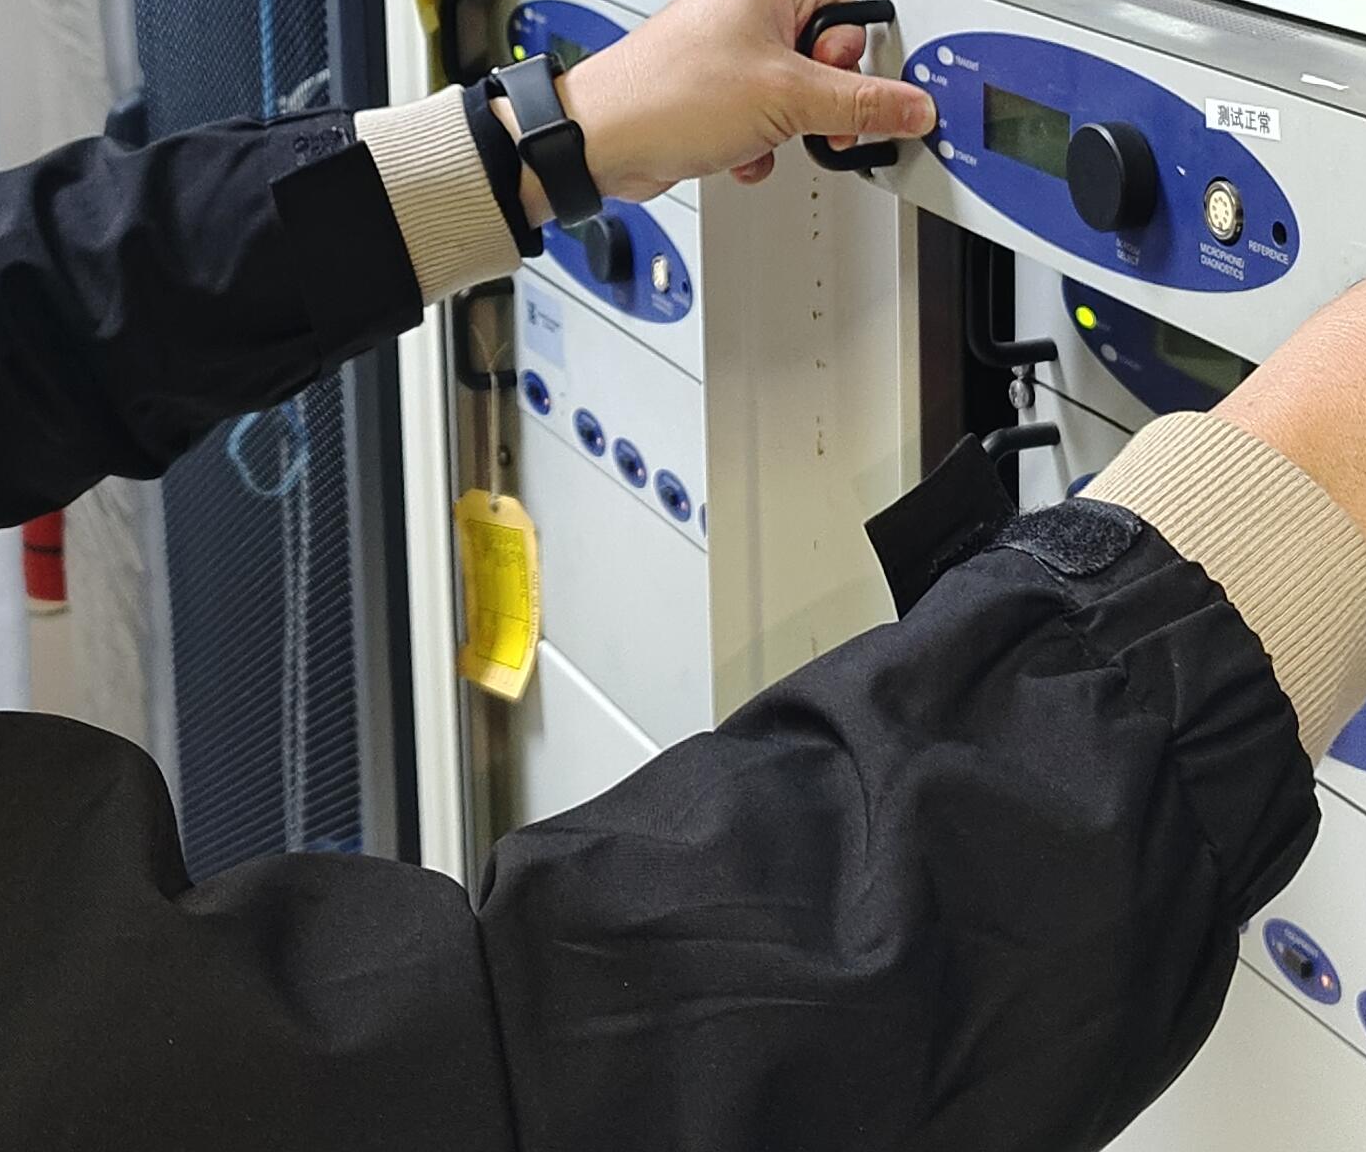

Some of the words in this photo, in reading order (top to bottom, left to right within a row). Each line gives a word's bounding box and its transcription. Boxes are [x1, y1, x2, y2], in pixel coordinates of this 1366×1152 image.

[1217, 105, 1270, 134] 测试正常
[1248, 239, 1289, 265] REFERENCE
[1200, 254, 1245, 281] DIAGNOSTICS
